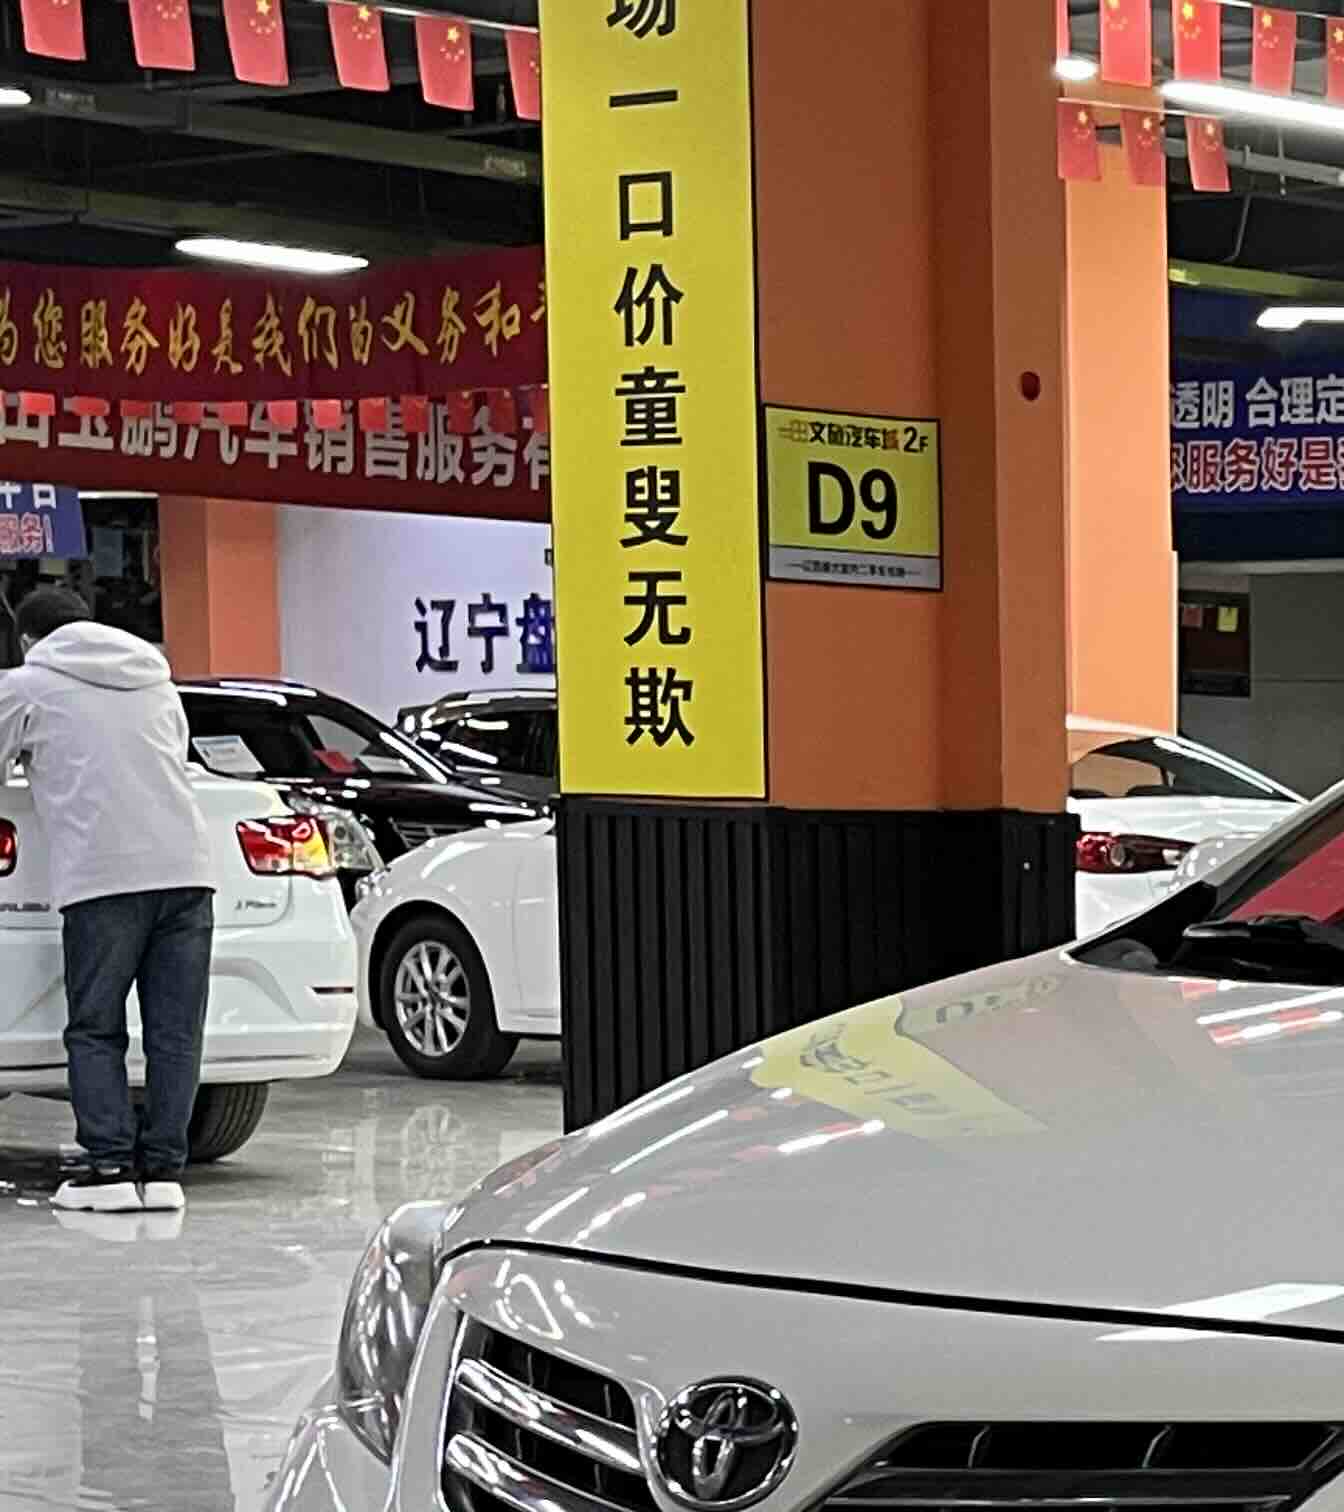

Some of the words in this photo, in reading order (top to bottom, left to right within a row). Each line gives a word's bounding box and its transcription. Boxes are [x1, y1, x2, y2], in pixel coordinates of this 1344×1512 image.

[0, 280, 547, 376] 为您服务好是我们的义务和
[807, 461, 899, 540] D9
